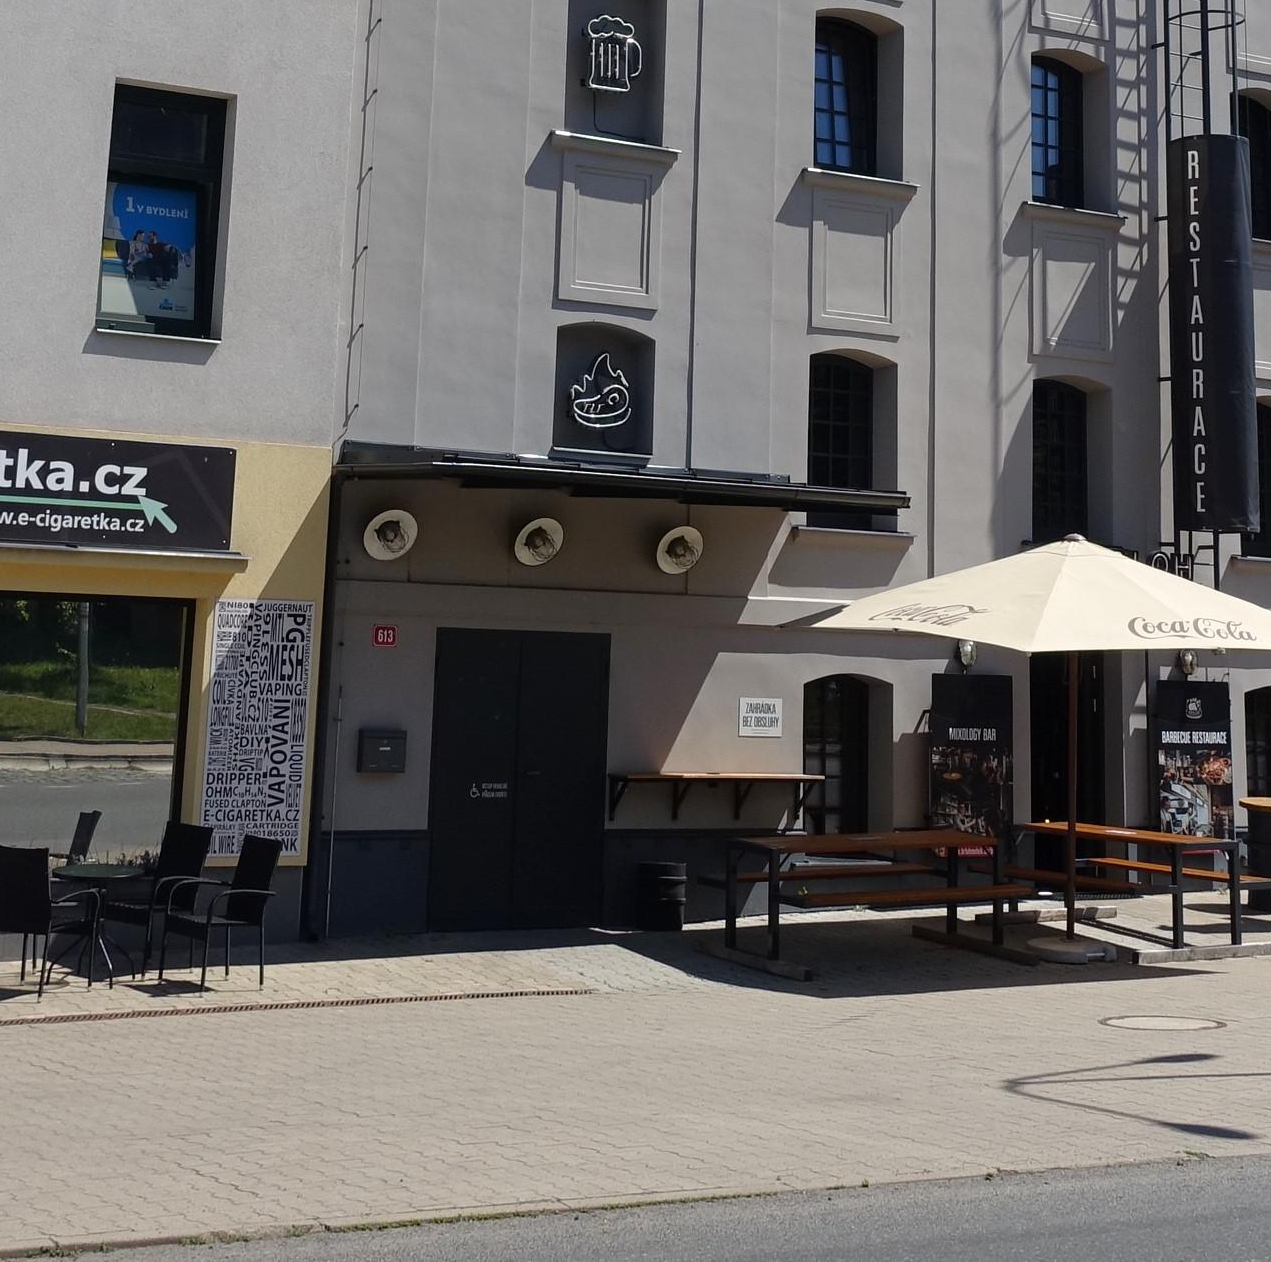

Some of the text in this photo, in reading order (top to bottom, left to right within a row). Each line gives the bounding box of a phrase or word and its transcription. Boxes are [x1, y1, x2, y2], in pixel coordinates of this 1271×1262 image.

[126, 196, 189, 219] 1 V BYDLENÍ
[1186, 150, 1206, 513] RESTAURACE
[264, 603, 313, 613] JUGGERNAUT
[286, 613, 306, 643] PG
[377, 629, 393, 642] 613
[248, 603, 264, 723] VAPINGCLUB.CZ
[269, 644, 304, 681] MESH
[259, 683, 302, 696] VAPING
[742, 716, 779, 728] BEZ OBSLUHY
[948, 727, 996, 742] MIXOLOGY BAR
[1161, 730, 1227, 745] BARBECUE RESTAURACE
[239, 737, 263, 747] DIY
[238, 758, 255, 772] VG
[288, 744, 304, 782] LIQUID
[206, 772, 262, 785] DRIPPER
[206, 786, 233, 798] OHM
[204, 799, 266, 808] FUSED CLAPTON
[203, 809, 300, 822] E-CIGARETKA.CZ
[262, 829, 290, 837] 18650
